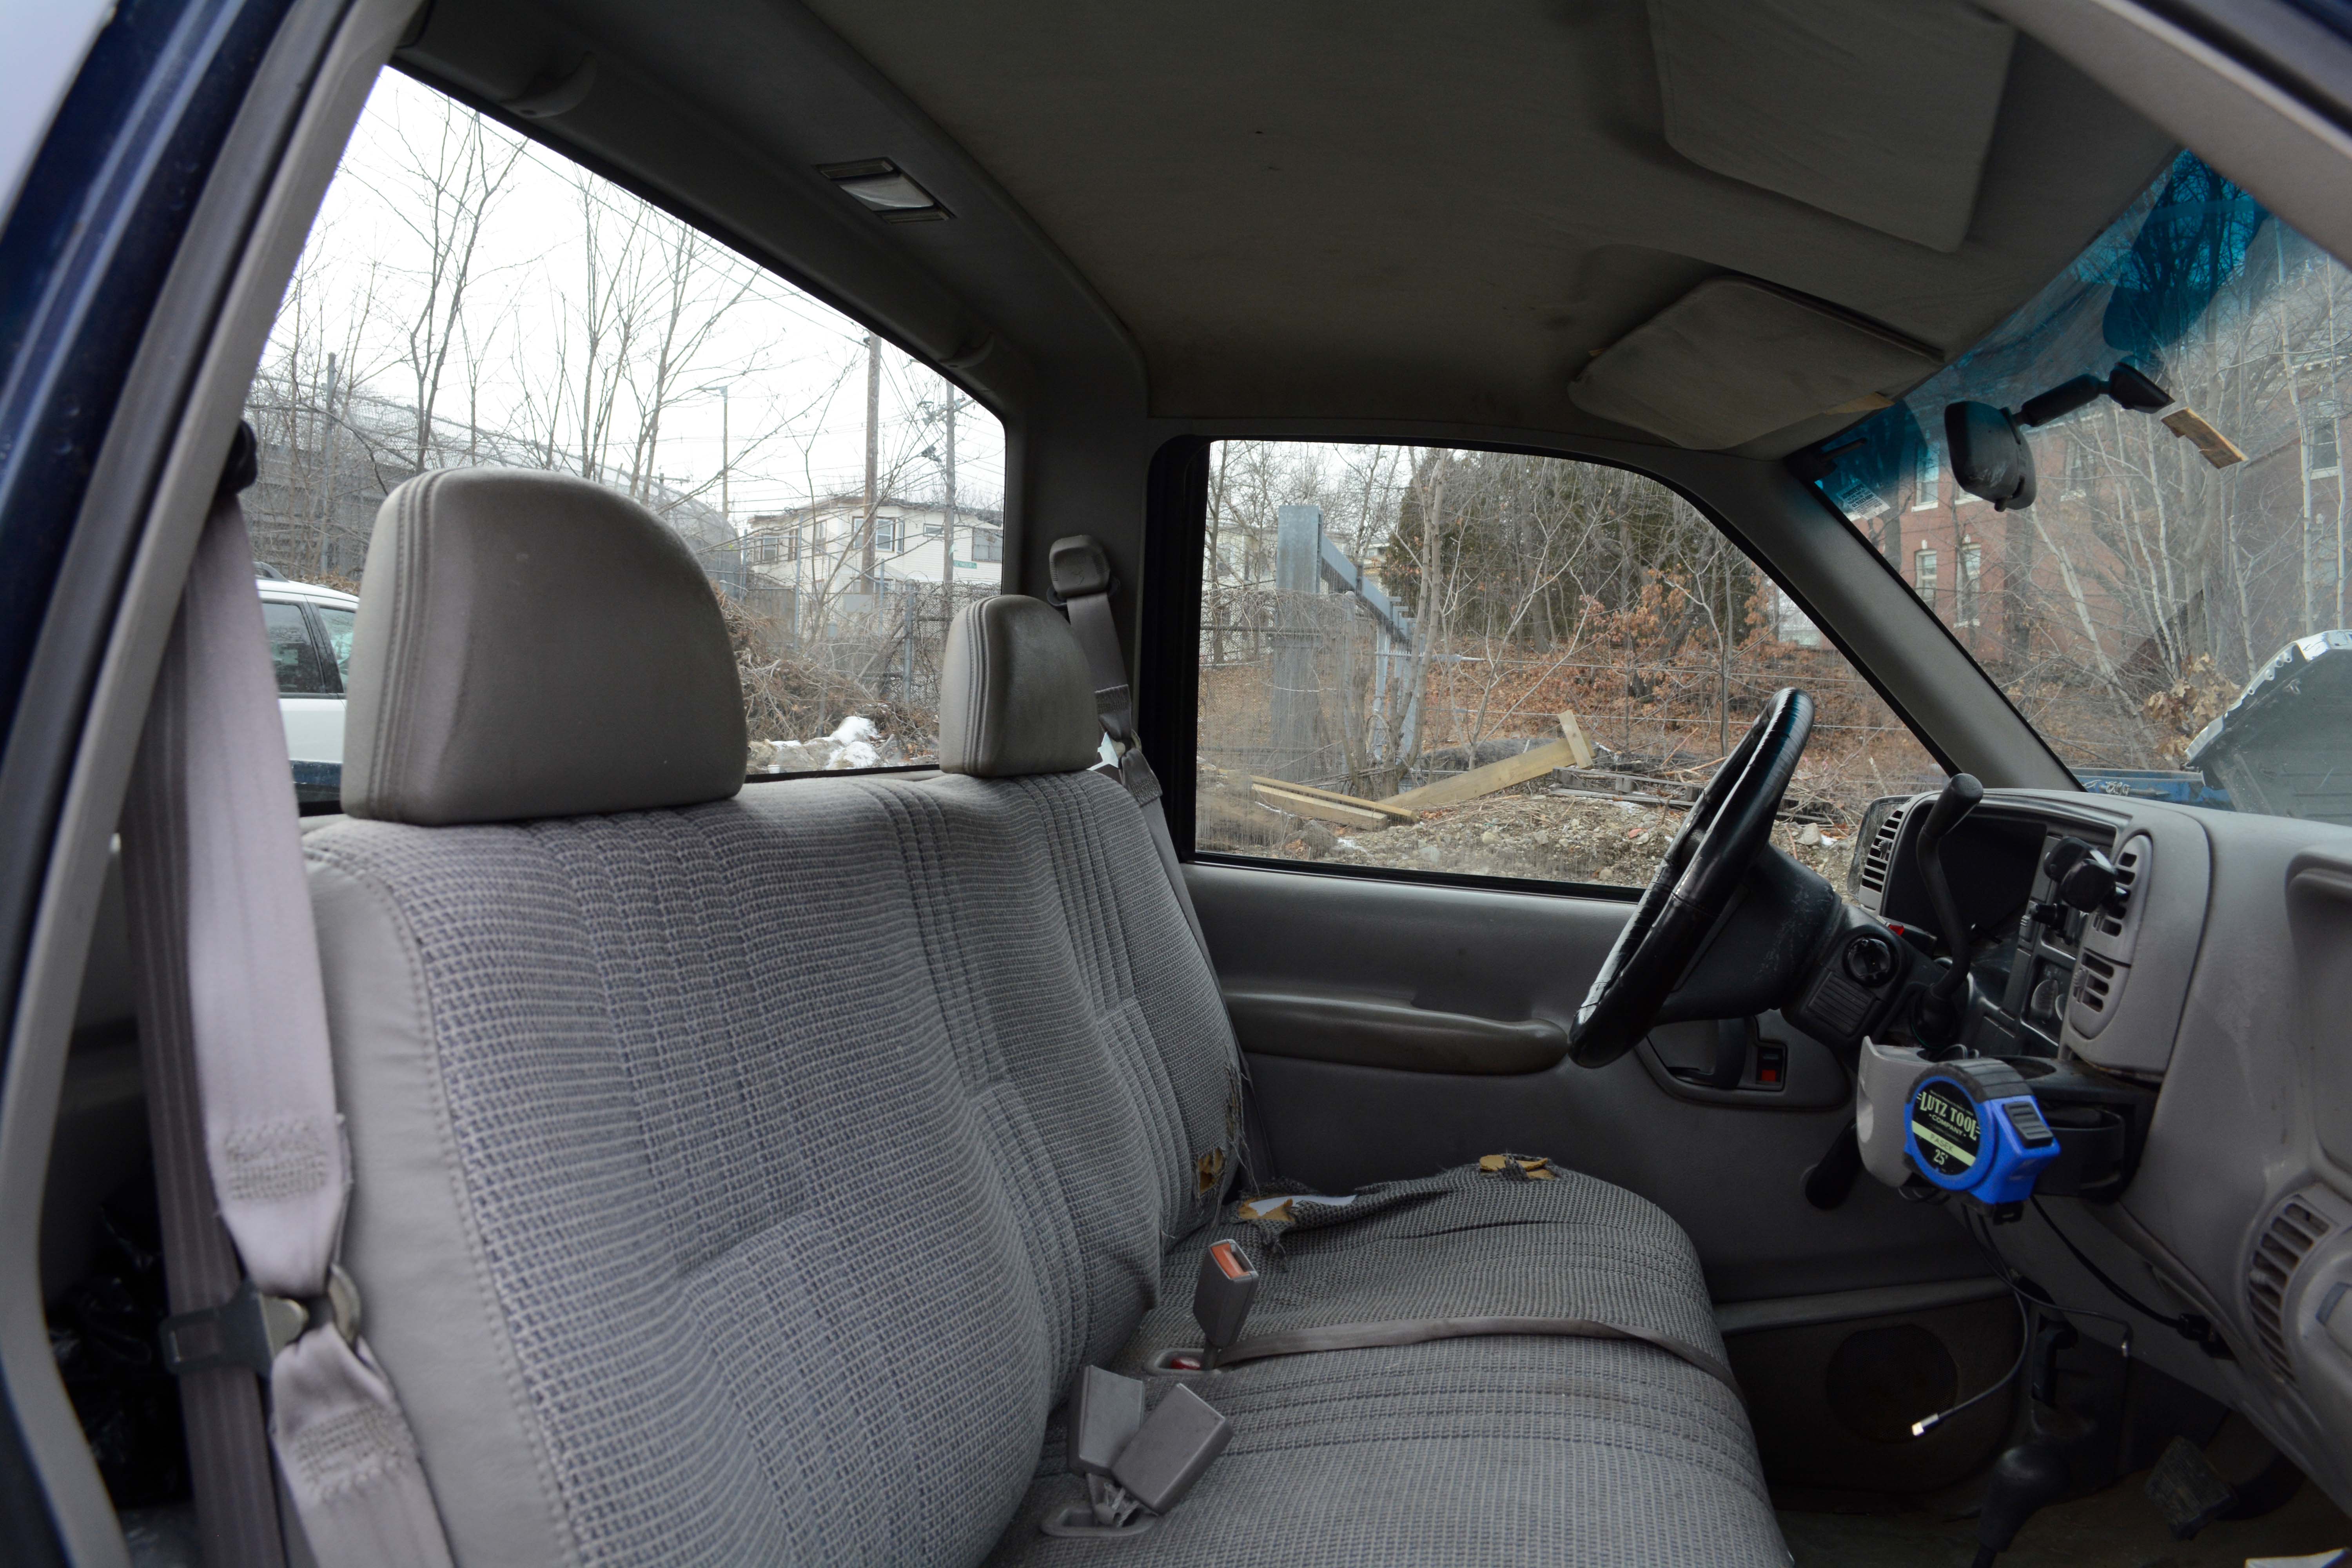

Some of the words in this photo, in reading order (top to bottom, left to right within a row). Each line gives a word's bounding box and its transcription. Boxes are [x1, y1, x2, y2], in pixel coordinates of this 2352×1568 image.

[1920, 1092, 1947, 1116] LUTZ
[1951, 1108, 1977, 1141] TOOL
[1932, 1115, 1962, 1134] COMPANY
